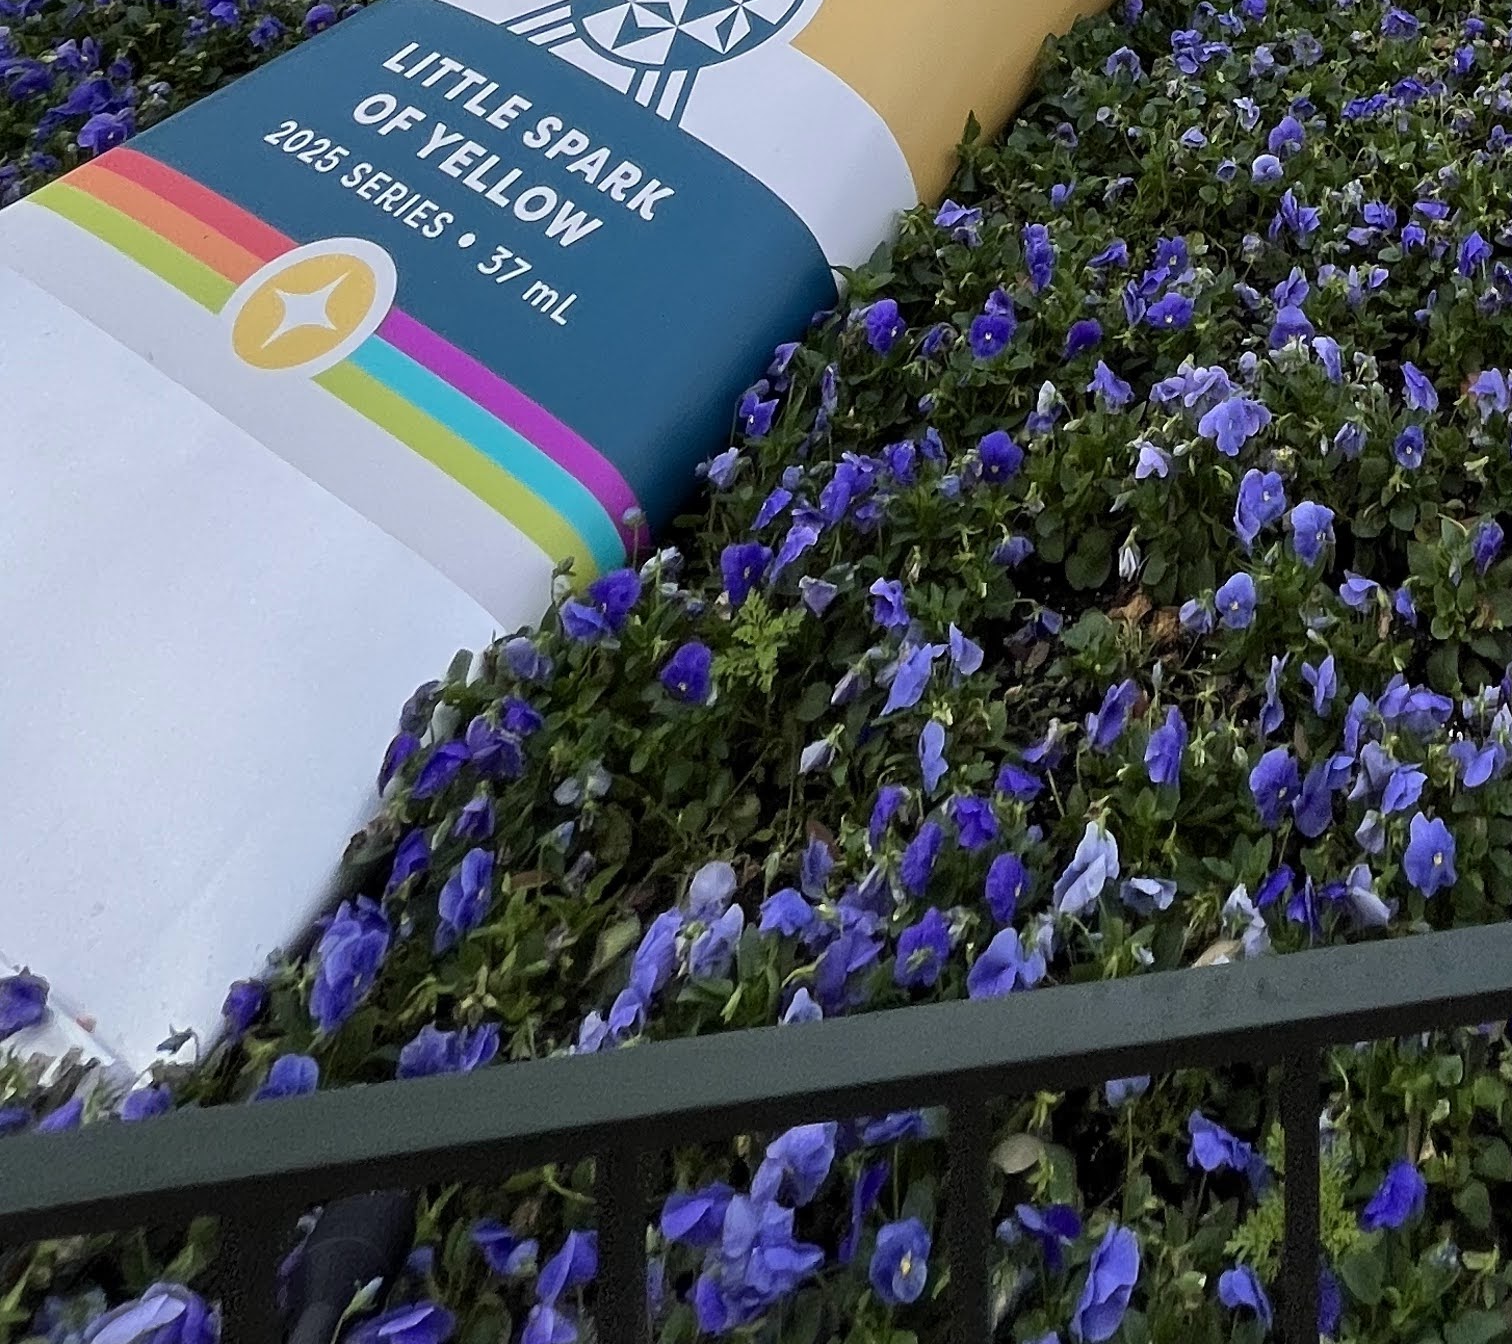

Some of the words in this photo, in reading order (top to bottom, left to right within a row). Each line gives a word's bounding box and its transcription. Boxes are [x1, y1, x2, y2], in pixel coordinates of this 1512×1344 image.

[352, 93, 426, 135] OF
[416, 122, 603, 248] YELLOW
[382, 42, 532, 130] LITTLE
[522, 116, 675, 221] SPARK
[263, 120, 349, 173] 2025
[340, 162, 455, 239] SERIES
[477, 245, 532, 283] 37
[521, 280, 578, 325] mL
